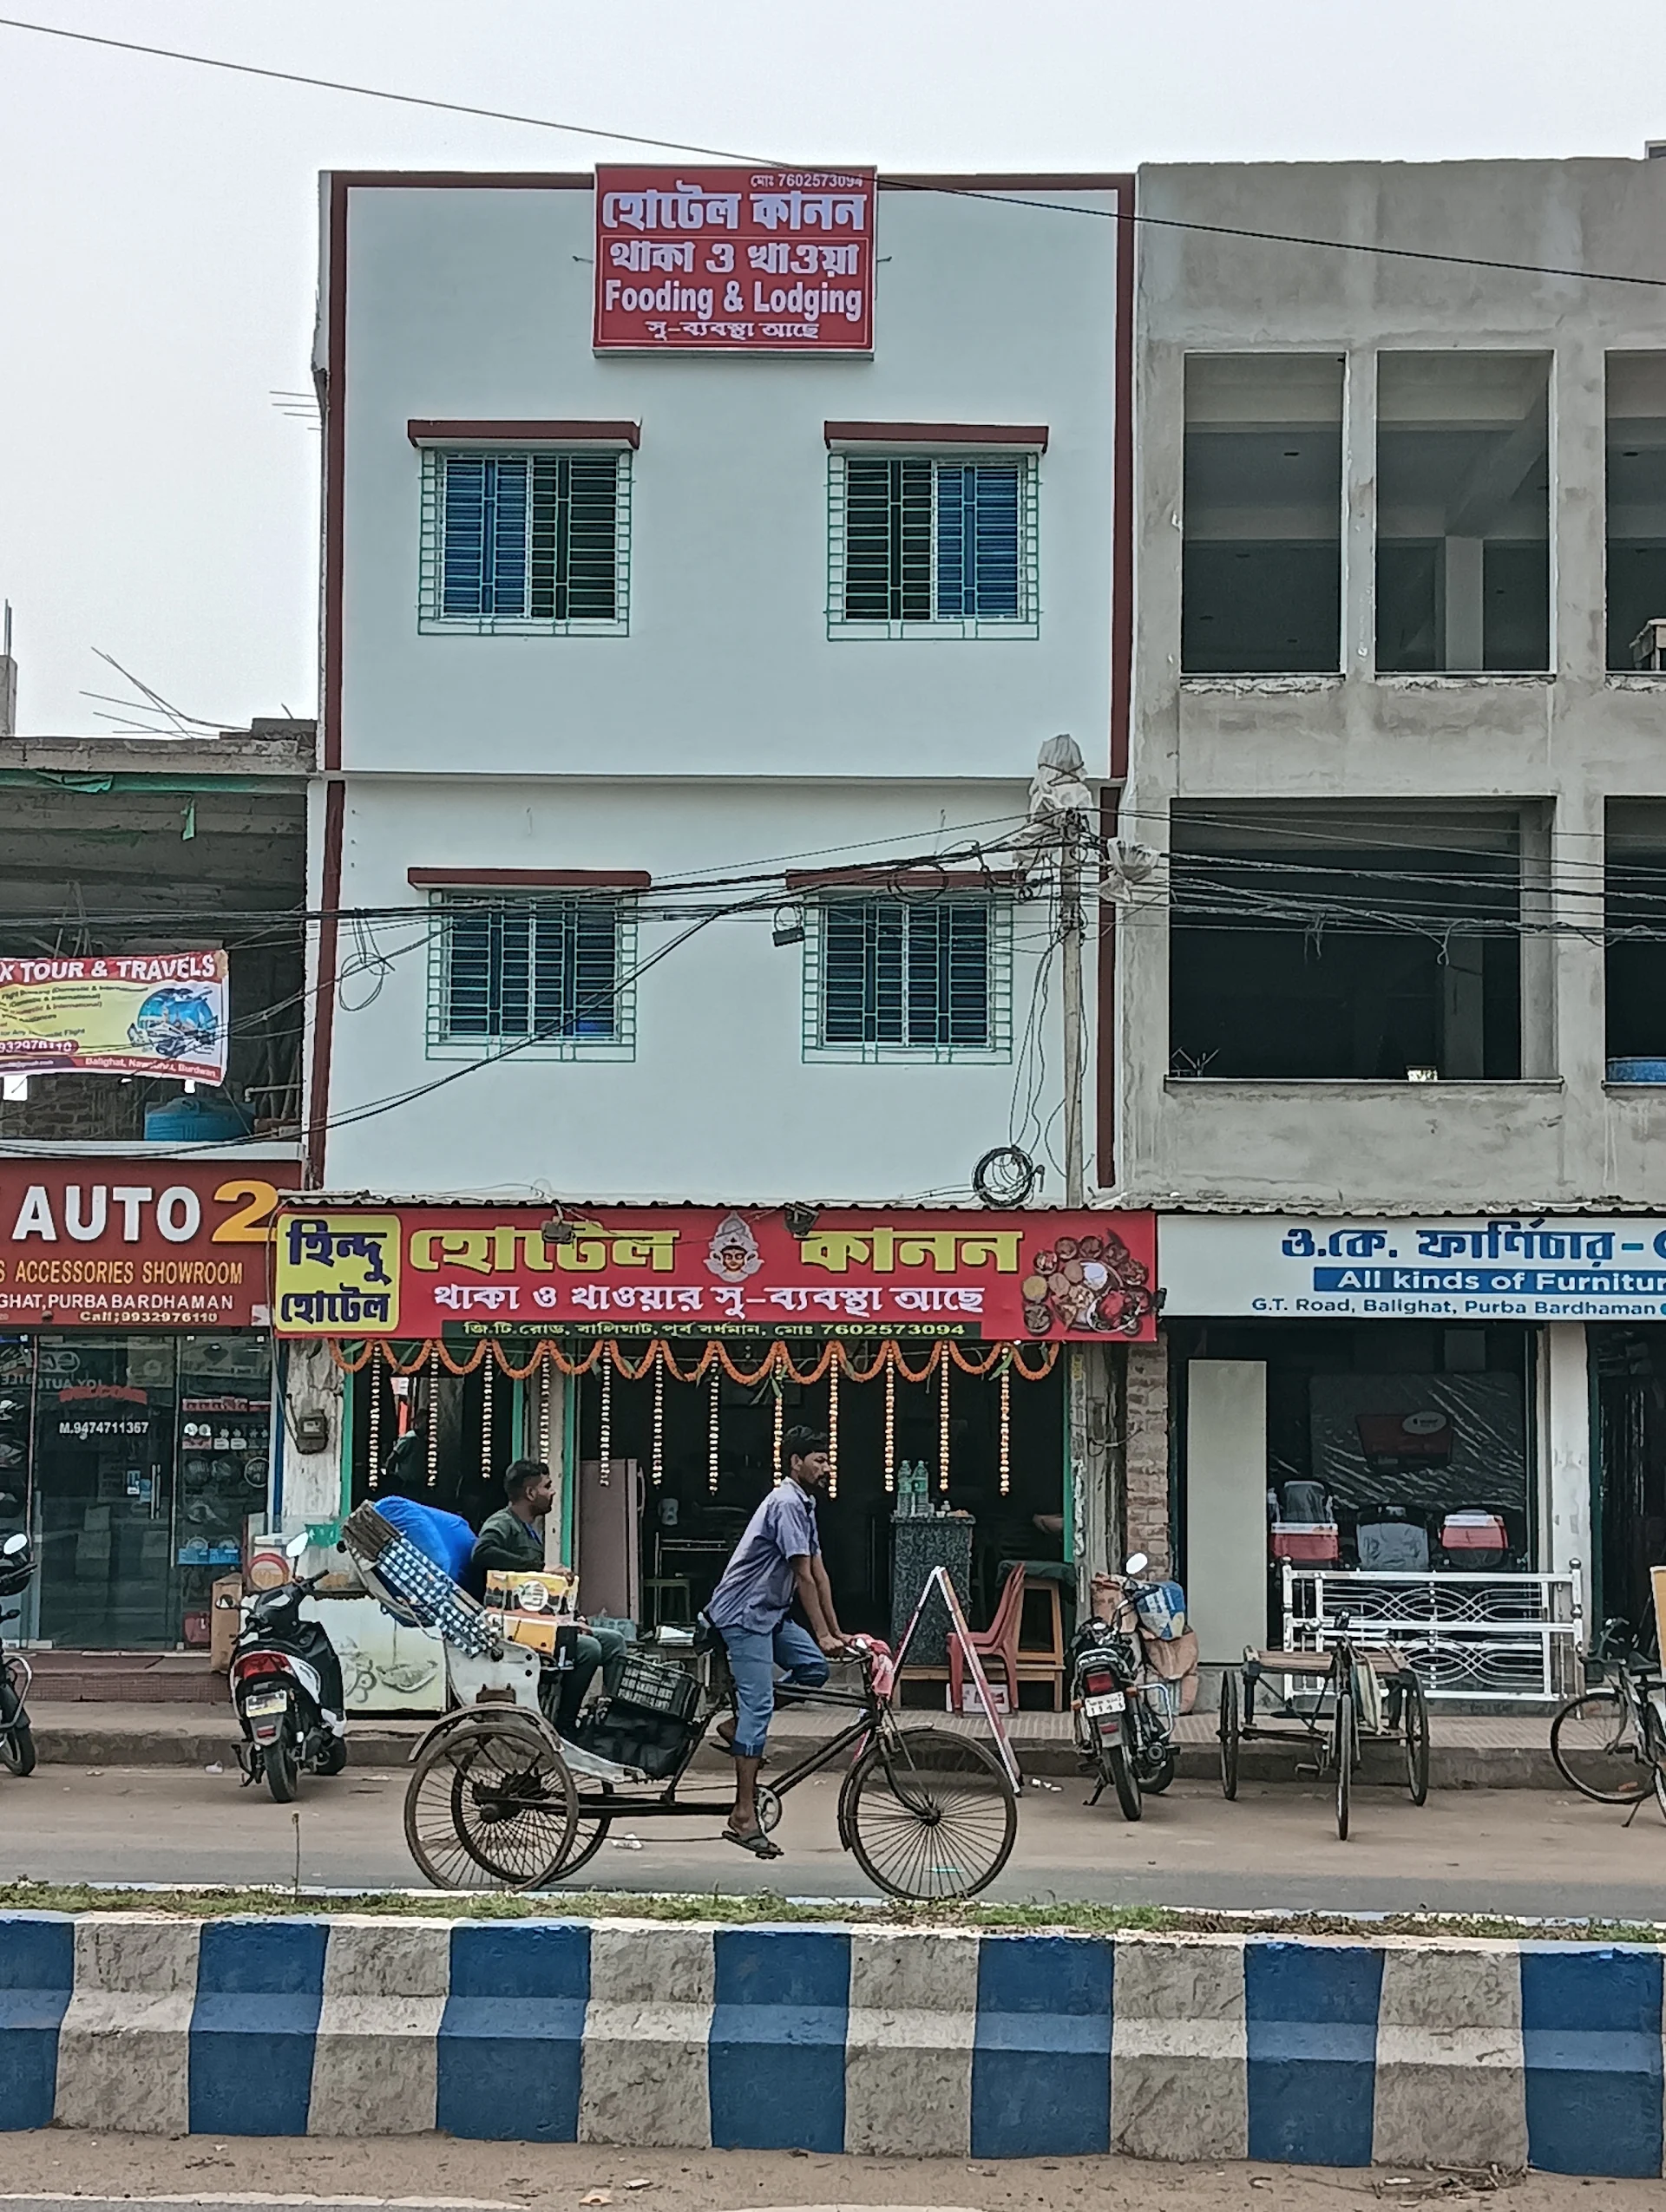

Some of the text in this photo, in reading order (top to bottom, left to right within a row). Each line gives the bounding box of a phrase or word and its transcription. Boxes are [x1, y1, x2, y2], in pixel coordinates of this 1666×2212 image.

[778, 173, 863, 187] 7602573094
[603, 180, 867, 231] হোটেল কানন
[610, 240, 859, 277] থাকা ও খাওয়া
[606, 279, 862, 321] Fooding & Lodging
[758, 323, 819, 338] আছে
[20, 961, 84, 983] TOUR
[91, 960, 108, 977] &
[116, 953, 215, 980] TRAVELS
[11, 1180, 278, 1242] AUTO 2
[285, 1219, 392, 1286] হিন্দু
[410, 1221, 1023, 1273] হোটেল কানন
[15, 1260, 134, 1284] ACCESSORIES
[142, 1261, 242, 1285] SHOWROOM
[1337, 1271, 1381, 1289] All
[1393, 1271, 1479, 1291] kinds
[1492, 1271, 1525, 1291] of
[115, 1294, 233, 1309] BARDHAMAN
[281, 1282, 390, 1325] হোটেল
[434, 1284, 521, 1310] থাকা
[533, 1286, 556, 1310] ও
[571, 1286, 704, 1312] খাওয়ার
[889, 1287, 985, 1312] আছে
[1252, 1299, 1656, 1315] G.T. Road, Balighat, Purba Bardhaman
[821, 1325, 965, 1336] 7602573094
